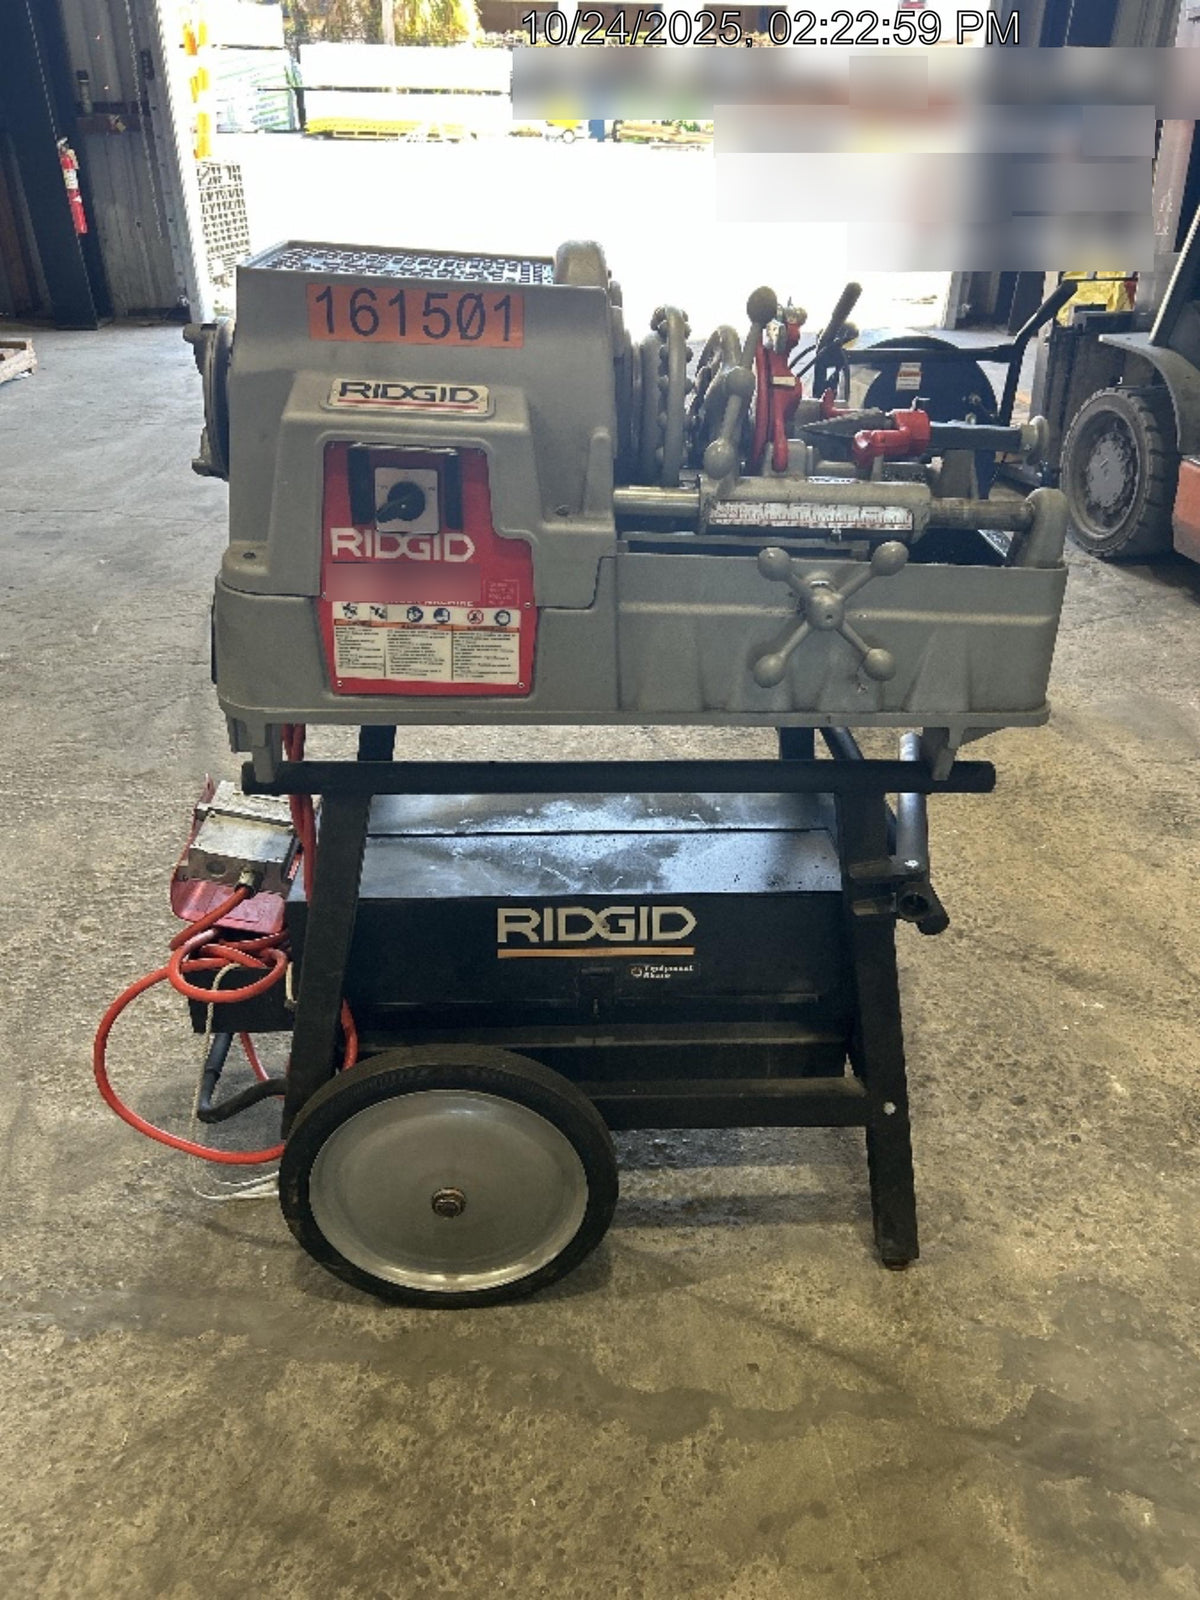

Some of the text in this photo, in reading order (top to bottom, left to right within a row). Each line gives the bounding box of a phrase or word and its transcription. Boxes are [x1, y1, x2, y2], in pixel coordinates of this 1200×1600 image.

[315, 285, 512, 342] 161501
[339, 381, 481, 403] RIDGID
[330, 527, 475, 563] RIDGID
[497, 906, 697, 943] RIDGID
